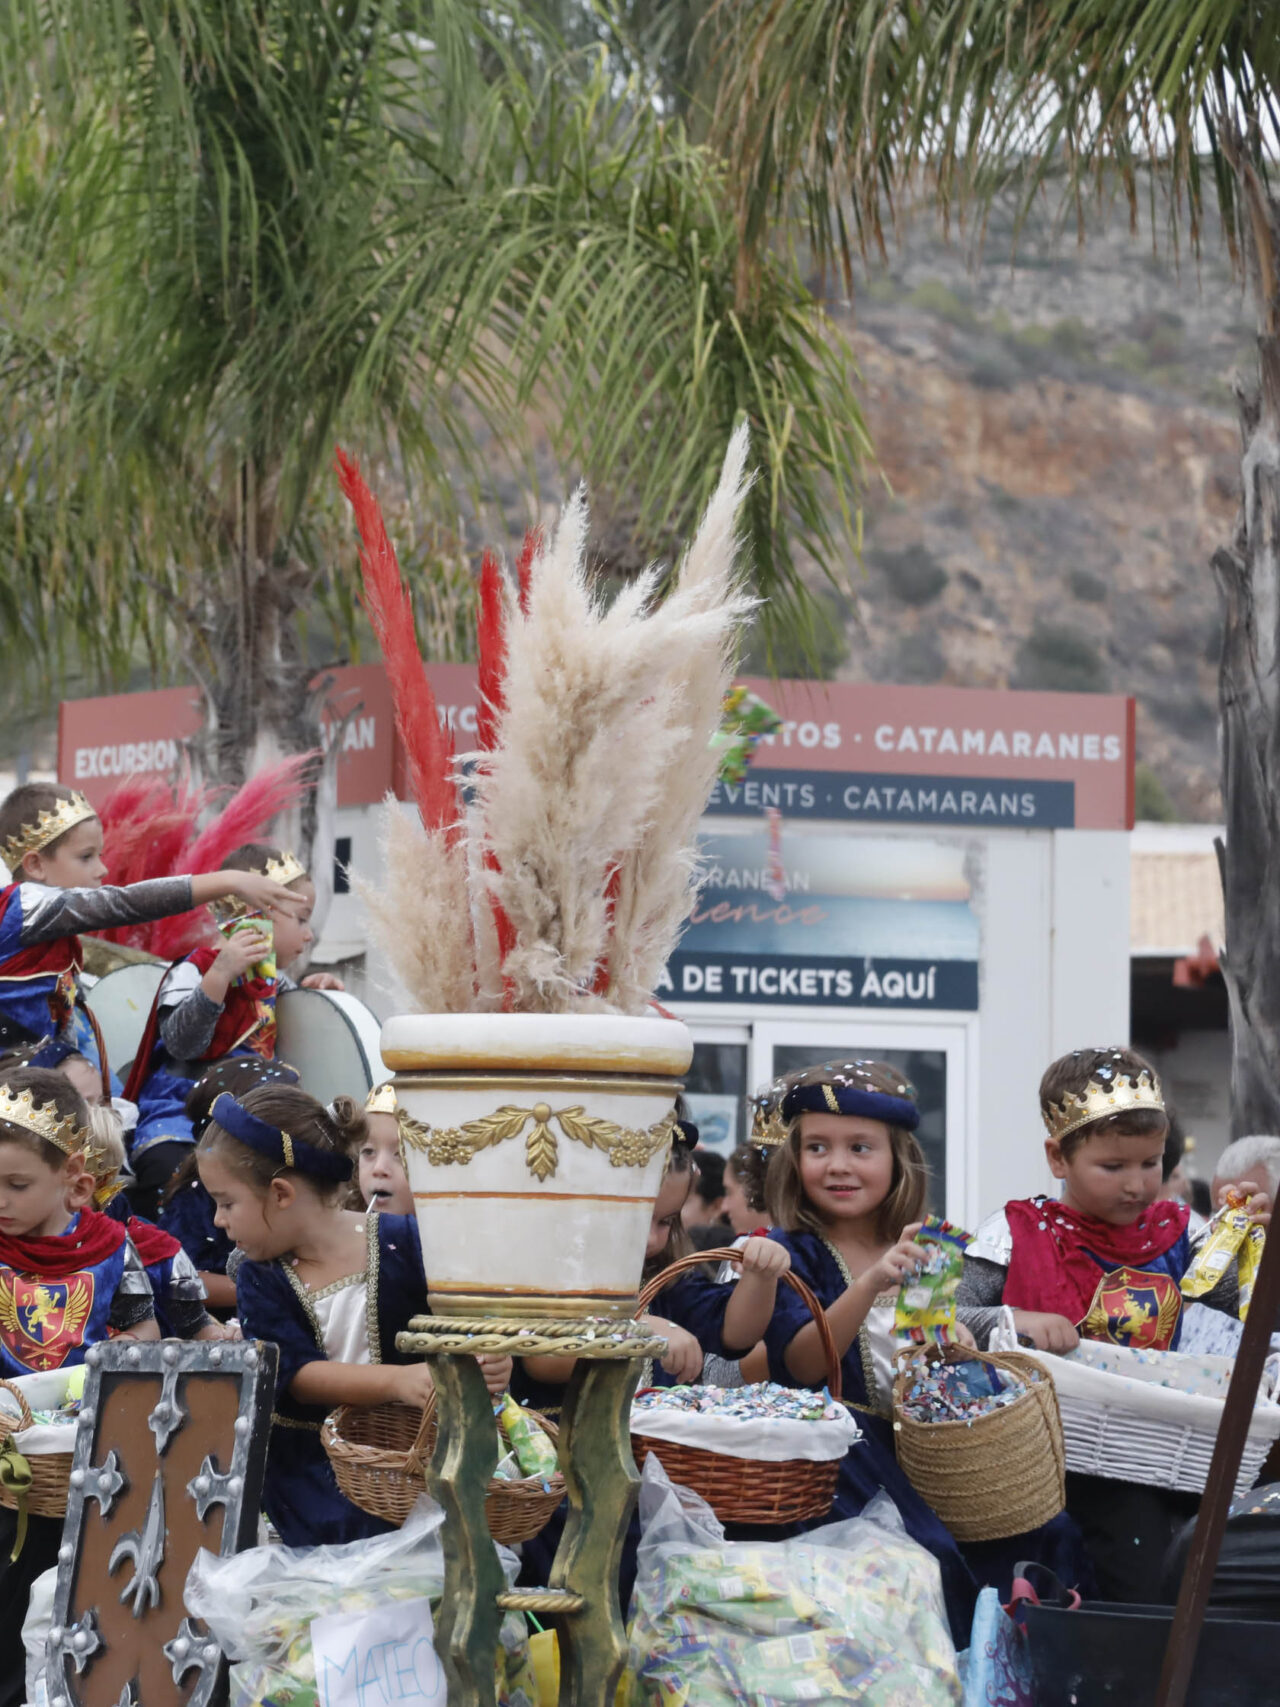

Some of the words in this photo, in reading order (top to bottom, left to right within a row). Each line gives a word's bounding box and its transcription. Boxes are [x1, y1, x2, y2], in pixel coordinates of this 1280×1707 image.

[874, 724, 1121, 761] CATAMARANES
[843, 785, 1036, 818] CATAMARANS
[682, 965, 723, 993] DE
[730, 966, 853, 997] TICKETS
[860, 966, 937, 1000] AQUÍ
[323, 1636, 440, 1707] MATEO
